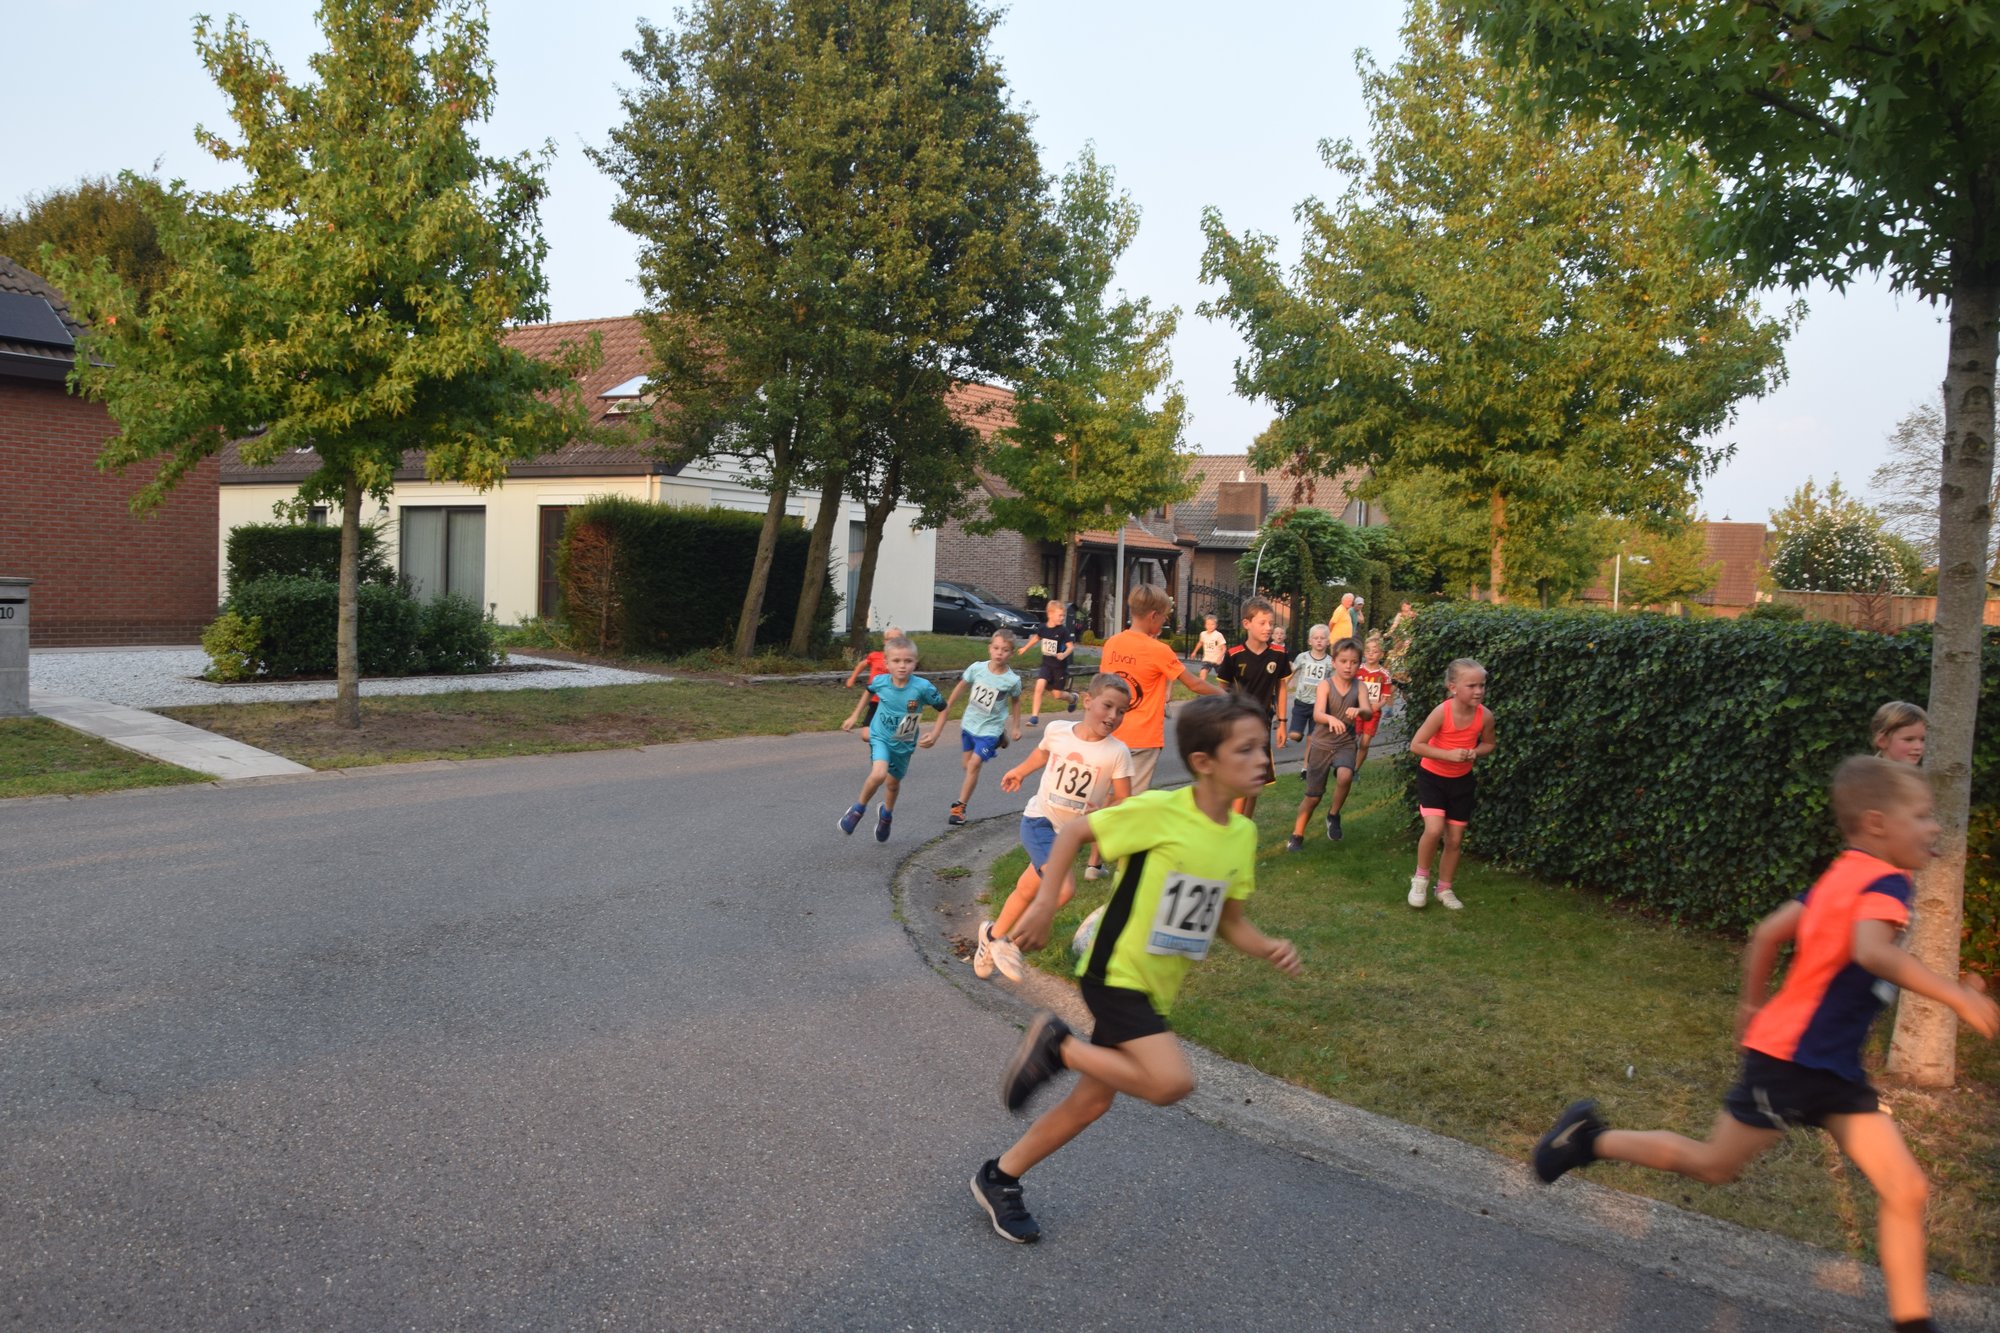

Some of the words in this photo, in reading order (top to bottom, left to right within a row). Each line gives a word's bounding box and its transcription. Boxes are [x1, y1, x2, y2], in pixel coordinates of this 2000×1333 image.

[0, 606, 15, 619] 10
[1043, 641, 1057, 653] 126
[1238, 663, 1247, 676] 7
[1307, 664, 1323, 679] 145
[974, 685, 994, 707] 123
[1368, 684, 1379, 697] 42
[879, 712, 901, 727] QAT
[899, 715, 919, 736] 121
[1056, 763, 1092, 798] 132
[1165, 880, 1219, 932] 128
